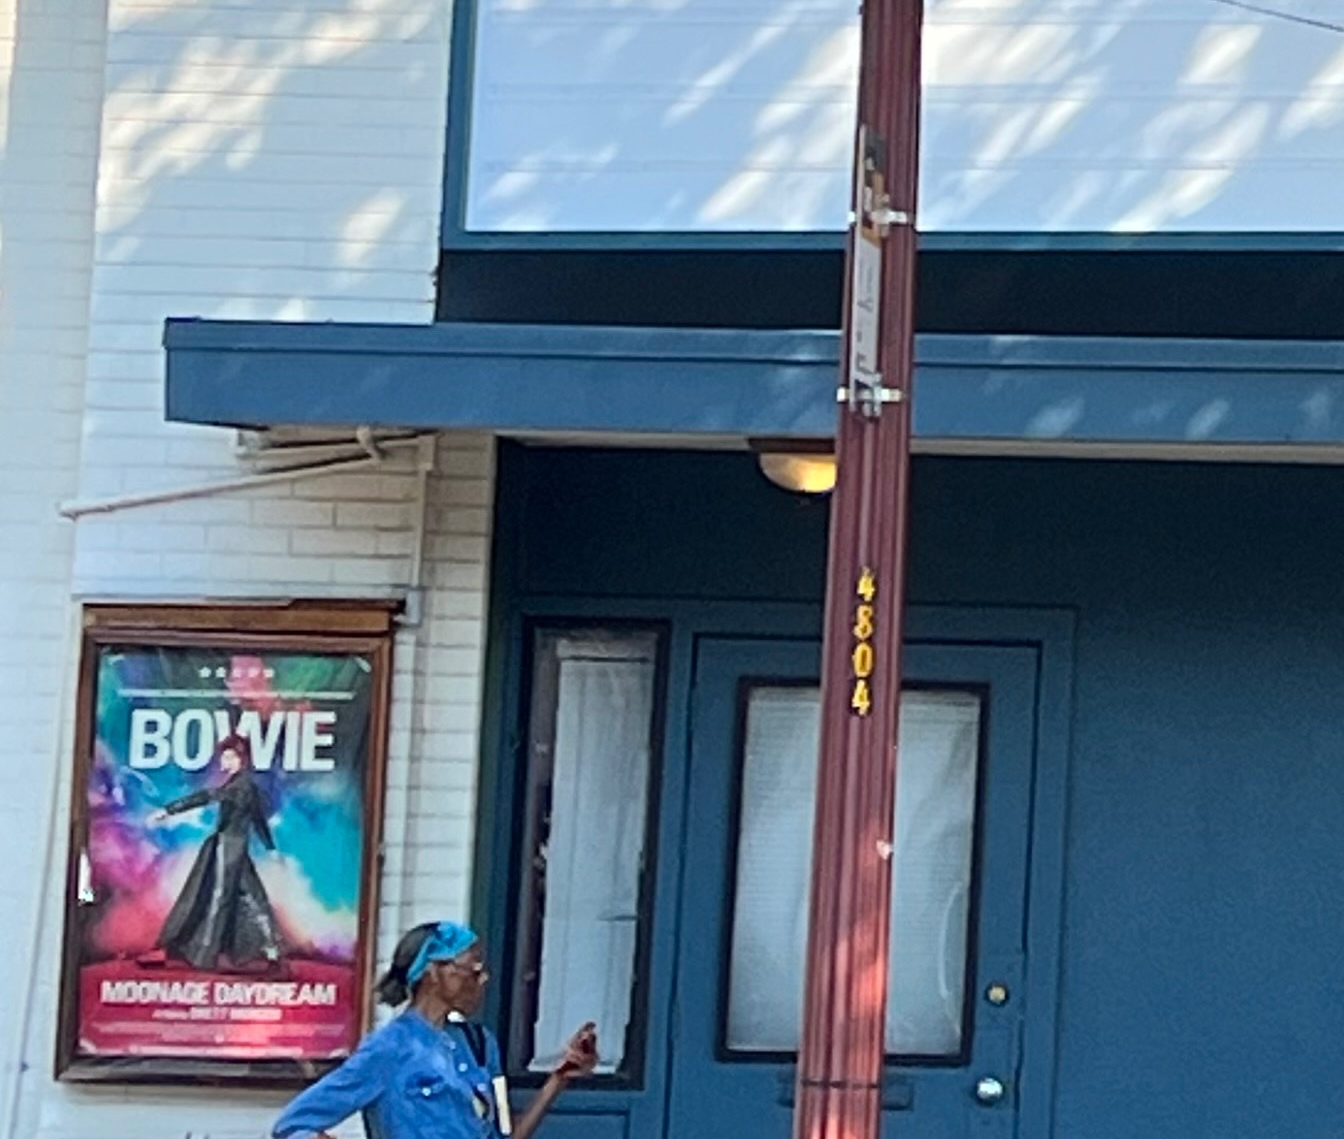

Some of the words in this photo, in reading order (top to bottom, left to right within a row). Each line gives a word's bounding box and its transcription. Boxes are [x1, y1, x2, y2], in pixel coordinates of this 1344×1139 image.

[851, 566, 875, 716] 4804
[129, 708, 336, 772] BOWIE
[101, 980, 209, 1004] MOONAGE
[213, 982, 337, 1005] DAYDREAM
